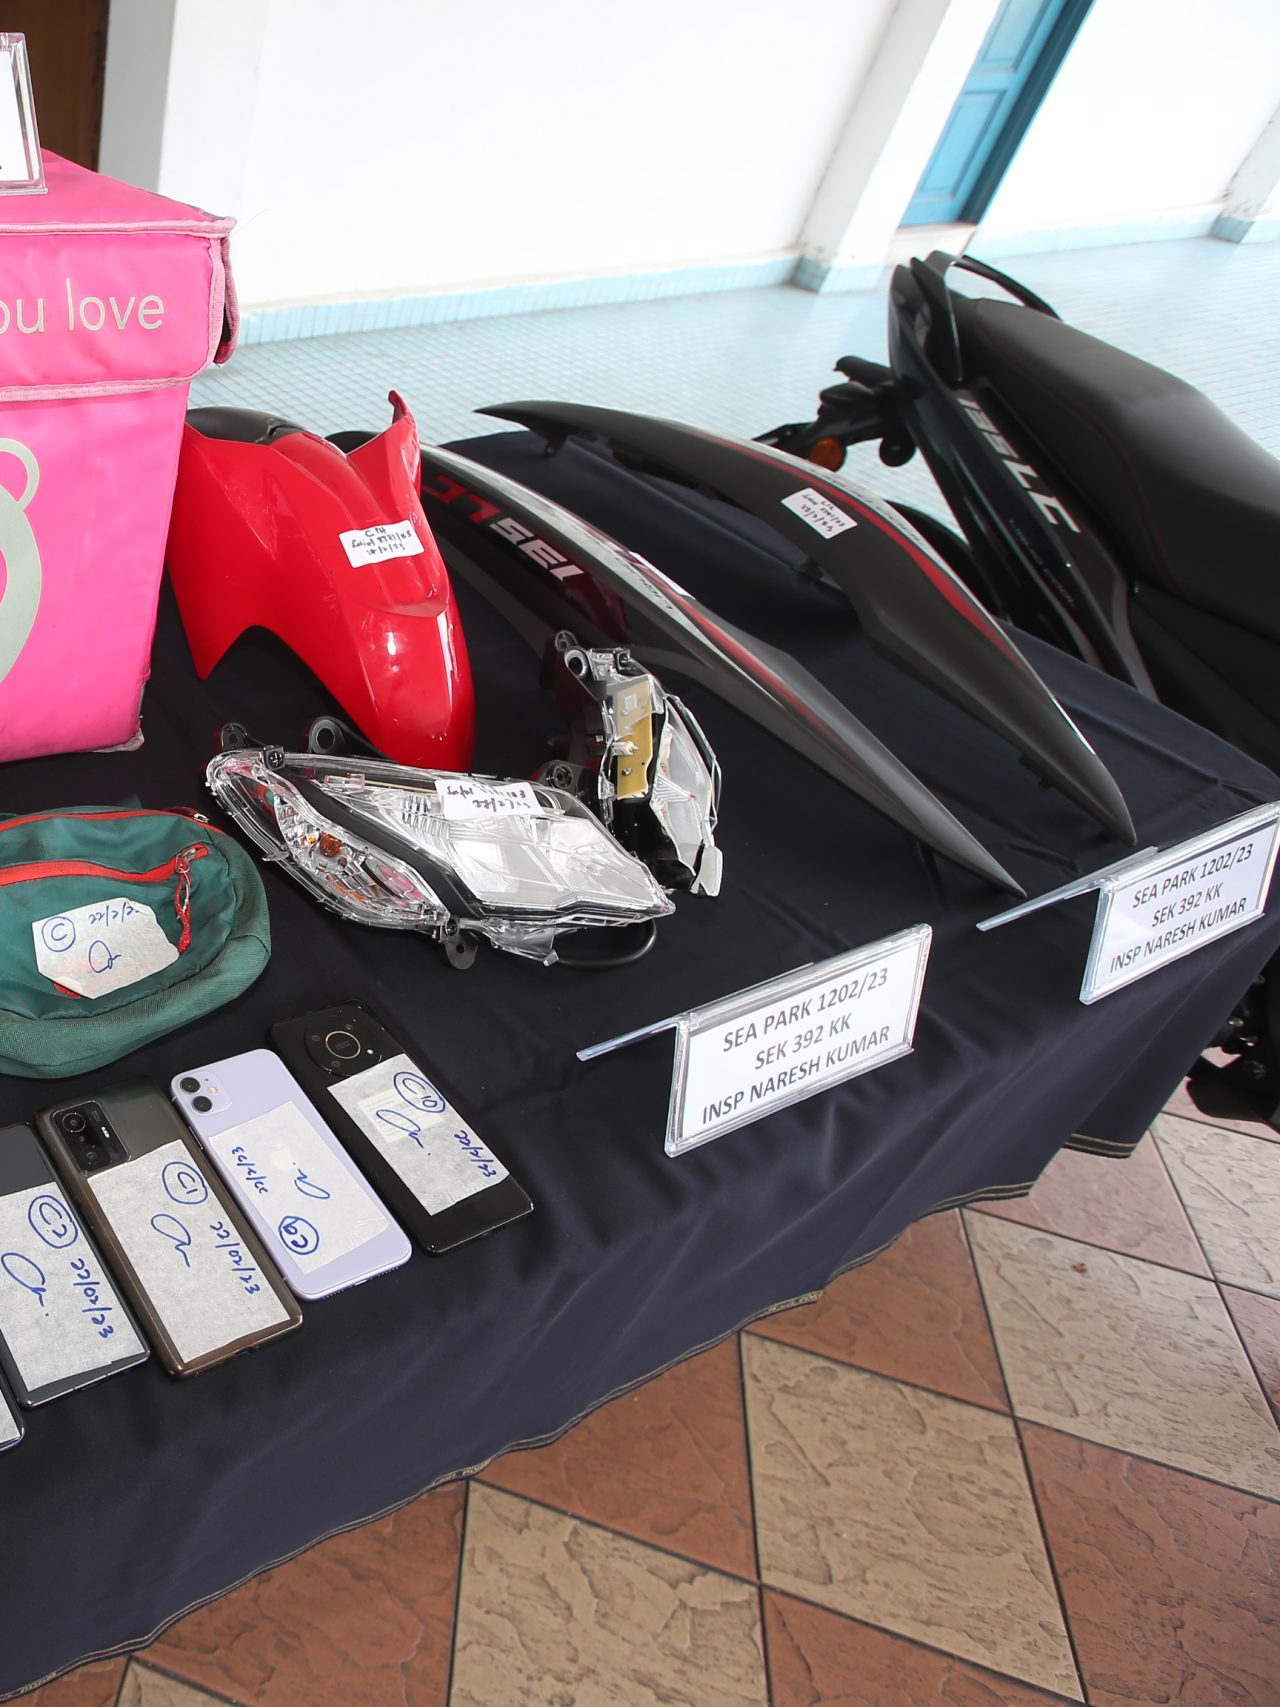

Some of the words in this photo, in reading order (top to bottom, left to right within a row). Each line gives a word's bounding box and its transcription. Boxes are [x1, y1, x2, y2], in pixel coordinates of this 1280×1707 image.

[65, 278, 166, 332] love
[1132, 886, 1157, 908] SEA
[1161, 866, 1197, 896] PARK
[1200, 843, 1253, 878] 1202/23
[1152, 906, 1176, 927] SEK
[1178, 892, 1201, 915] 392
[1205, 882, 1223, 904] KK
[89, 902, 139, 926] 22/2/2
[1110, 946, 1141, 973] INSP
[1143, 919, 1195, 957] NARESH
[1198, 898, 1247, 932] KUMAR
[723, 1022, 758, 1052] SEA
[763, 998, 813, 1036] PARK
[817, 967, 888, 1012] 1202/23
[755, 1044, 788, 1070] SEK
[792, 1025, 824, 1054] 392
[829, 1013, 852, 1037] KK
[702, 1091, 744, 1125] INSP
[749, 1056, 821, 1103] NARESH
[825, 1026, 890, 1068] KUMAR
